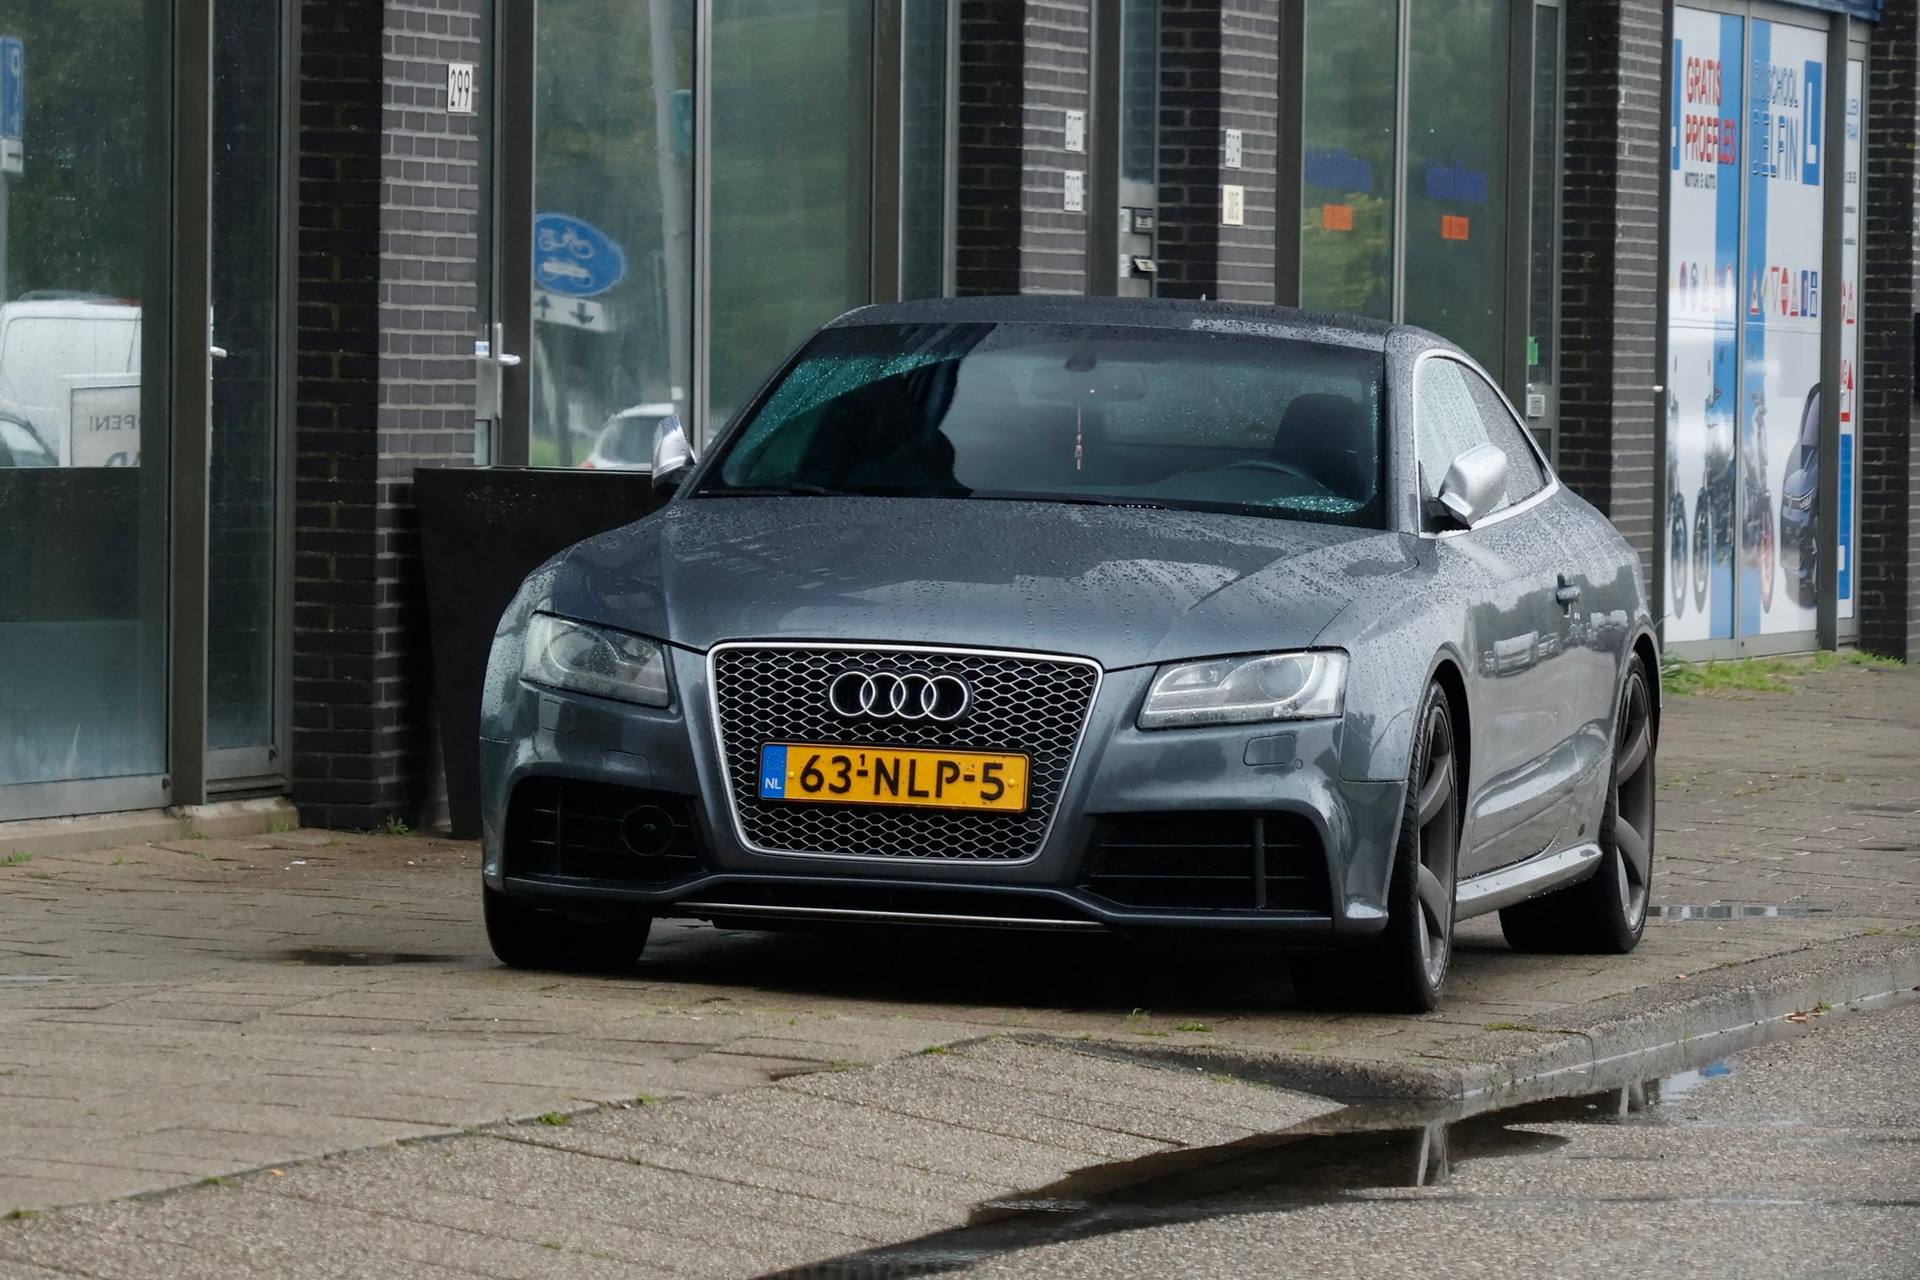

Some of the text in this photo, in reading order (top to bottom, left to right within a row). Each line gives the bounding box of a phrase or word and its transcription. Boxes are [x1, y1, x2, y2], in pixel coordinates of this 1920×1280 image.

[450, 69, 470, 107] 299
[1687, 56, 1722, 106] GRATIS
[1685, 113, 1736, 165] PROEFLES
[764, 777, 782, 790] NL
[800, 754, 1005, 802] 63-NLP-5
